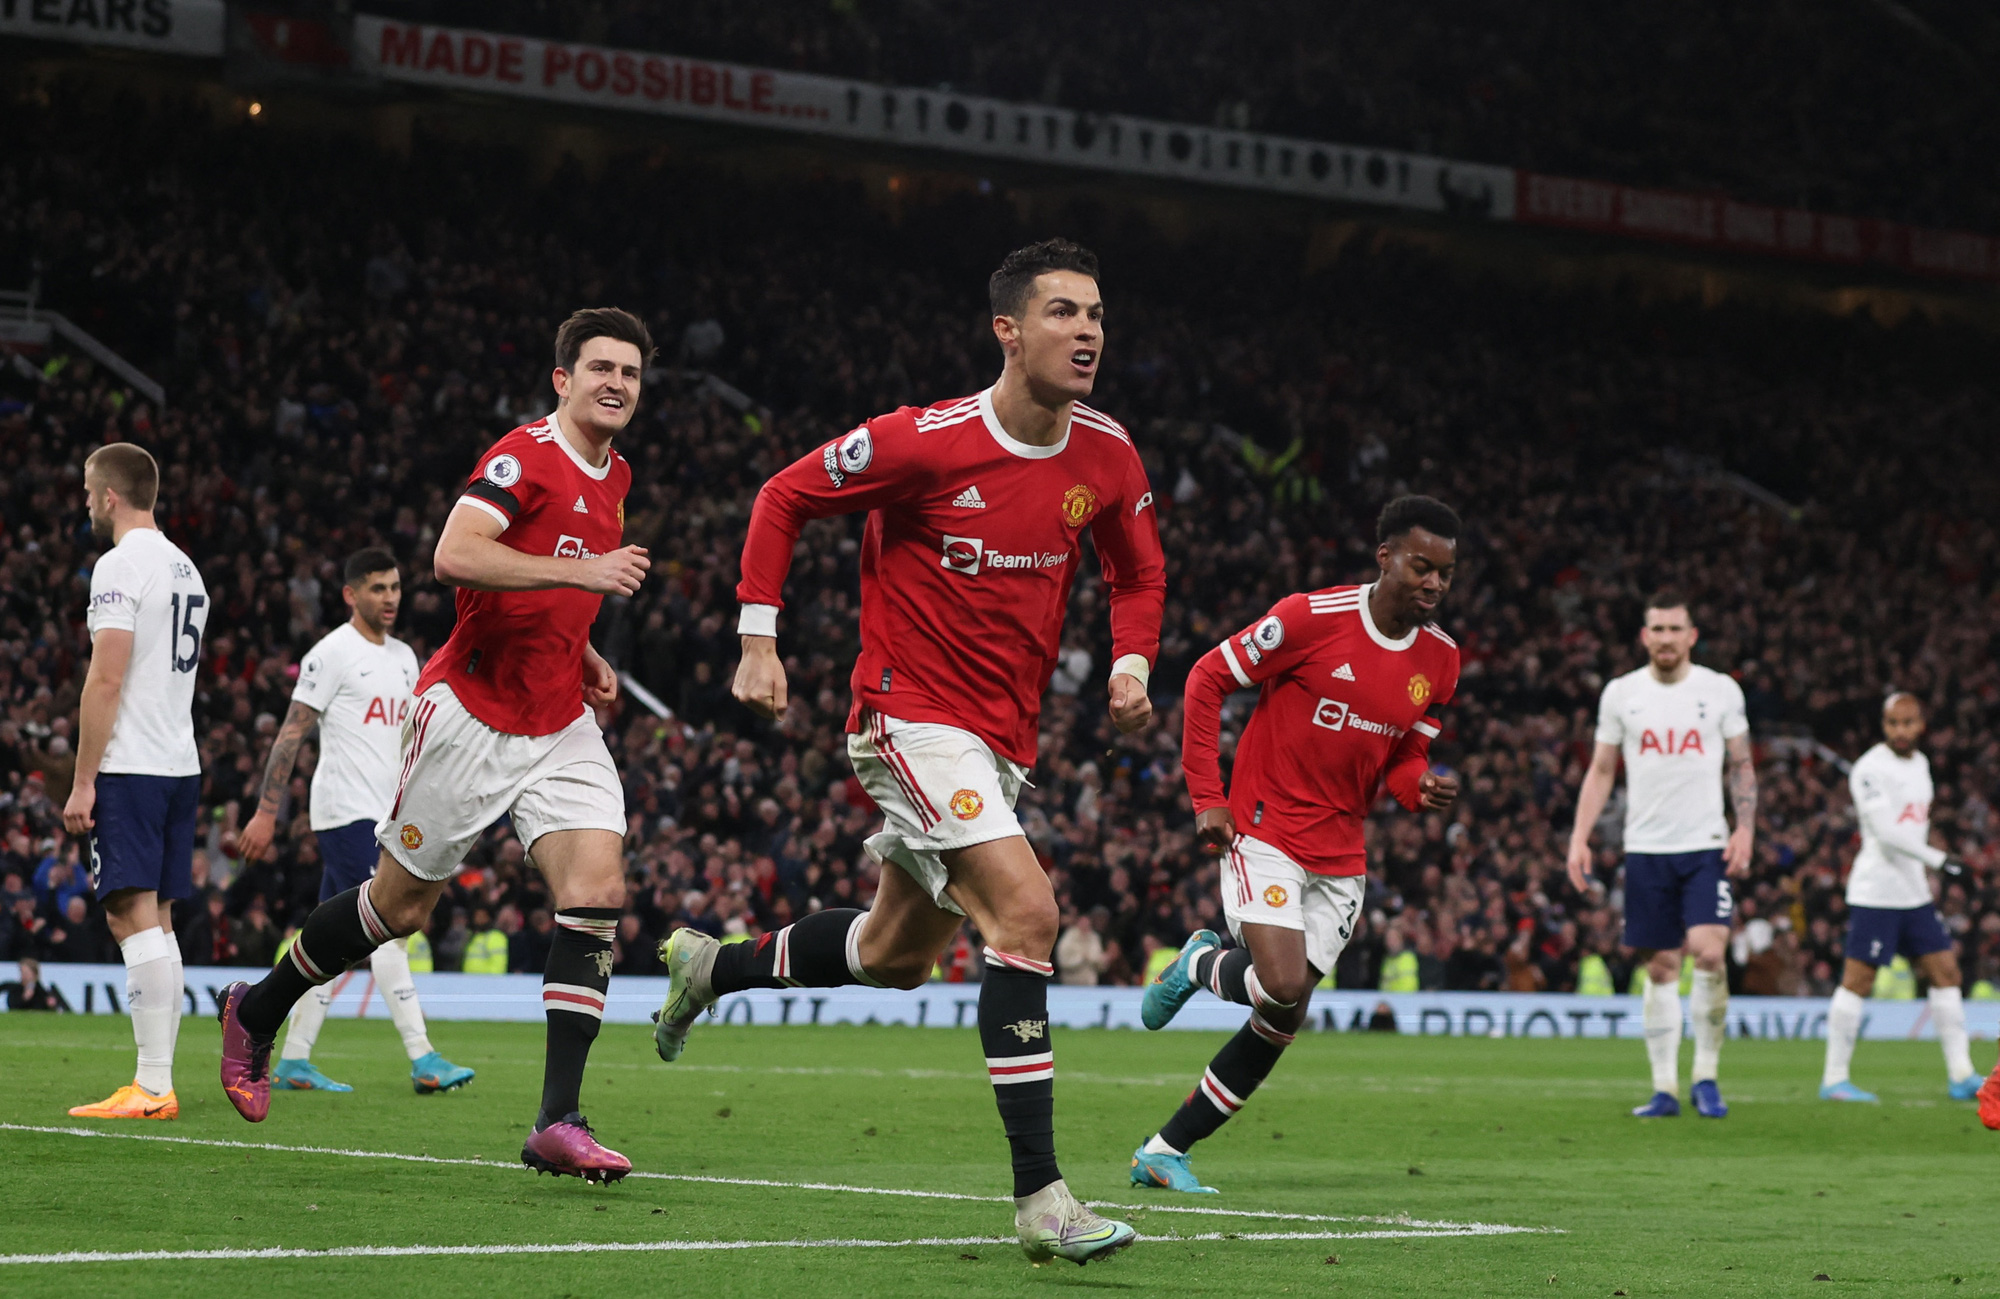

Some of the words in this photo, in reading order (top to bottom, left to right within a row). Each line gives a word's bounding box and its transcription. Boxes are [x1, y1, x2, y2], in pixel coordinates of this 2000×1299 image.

[380, 25, 522, 82] MADE
[952, 499, 987, 509] adidas
[171, 591, 206, 673] 15
[1639, 728, 1705, 755] AIA
[1717, 880, 1733, 918] 5
